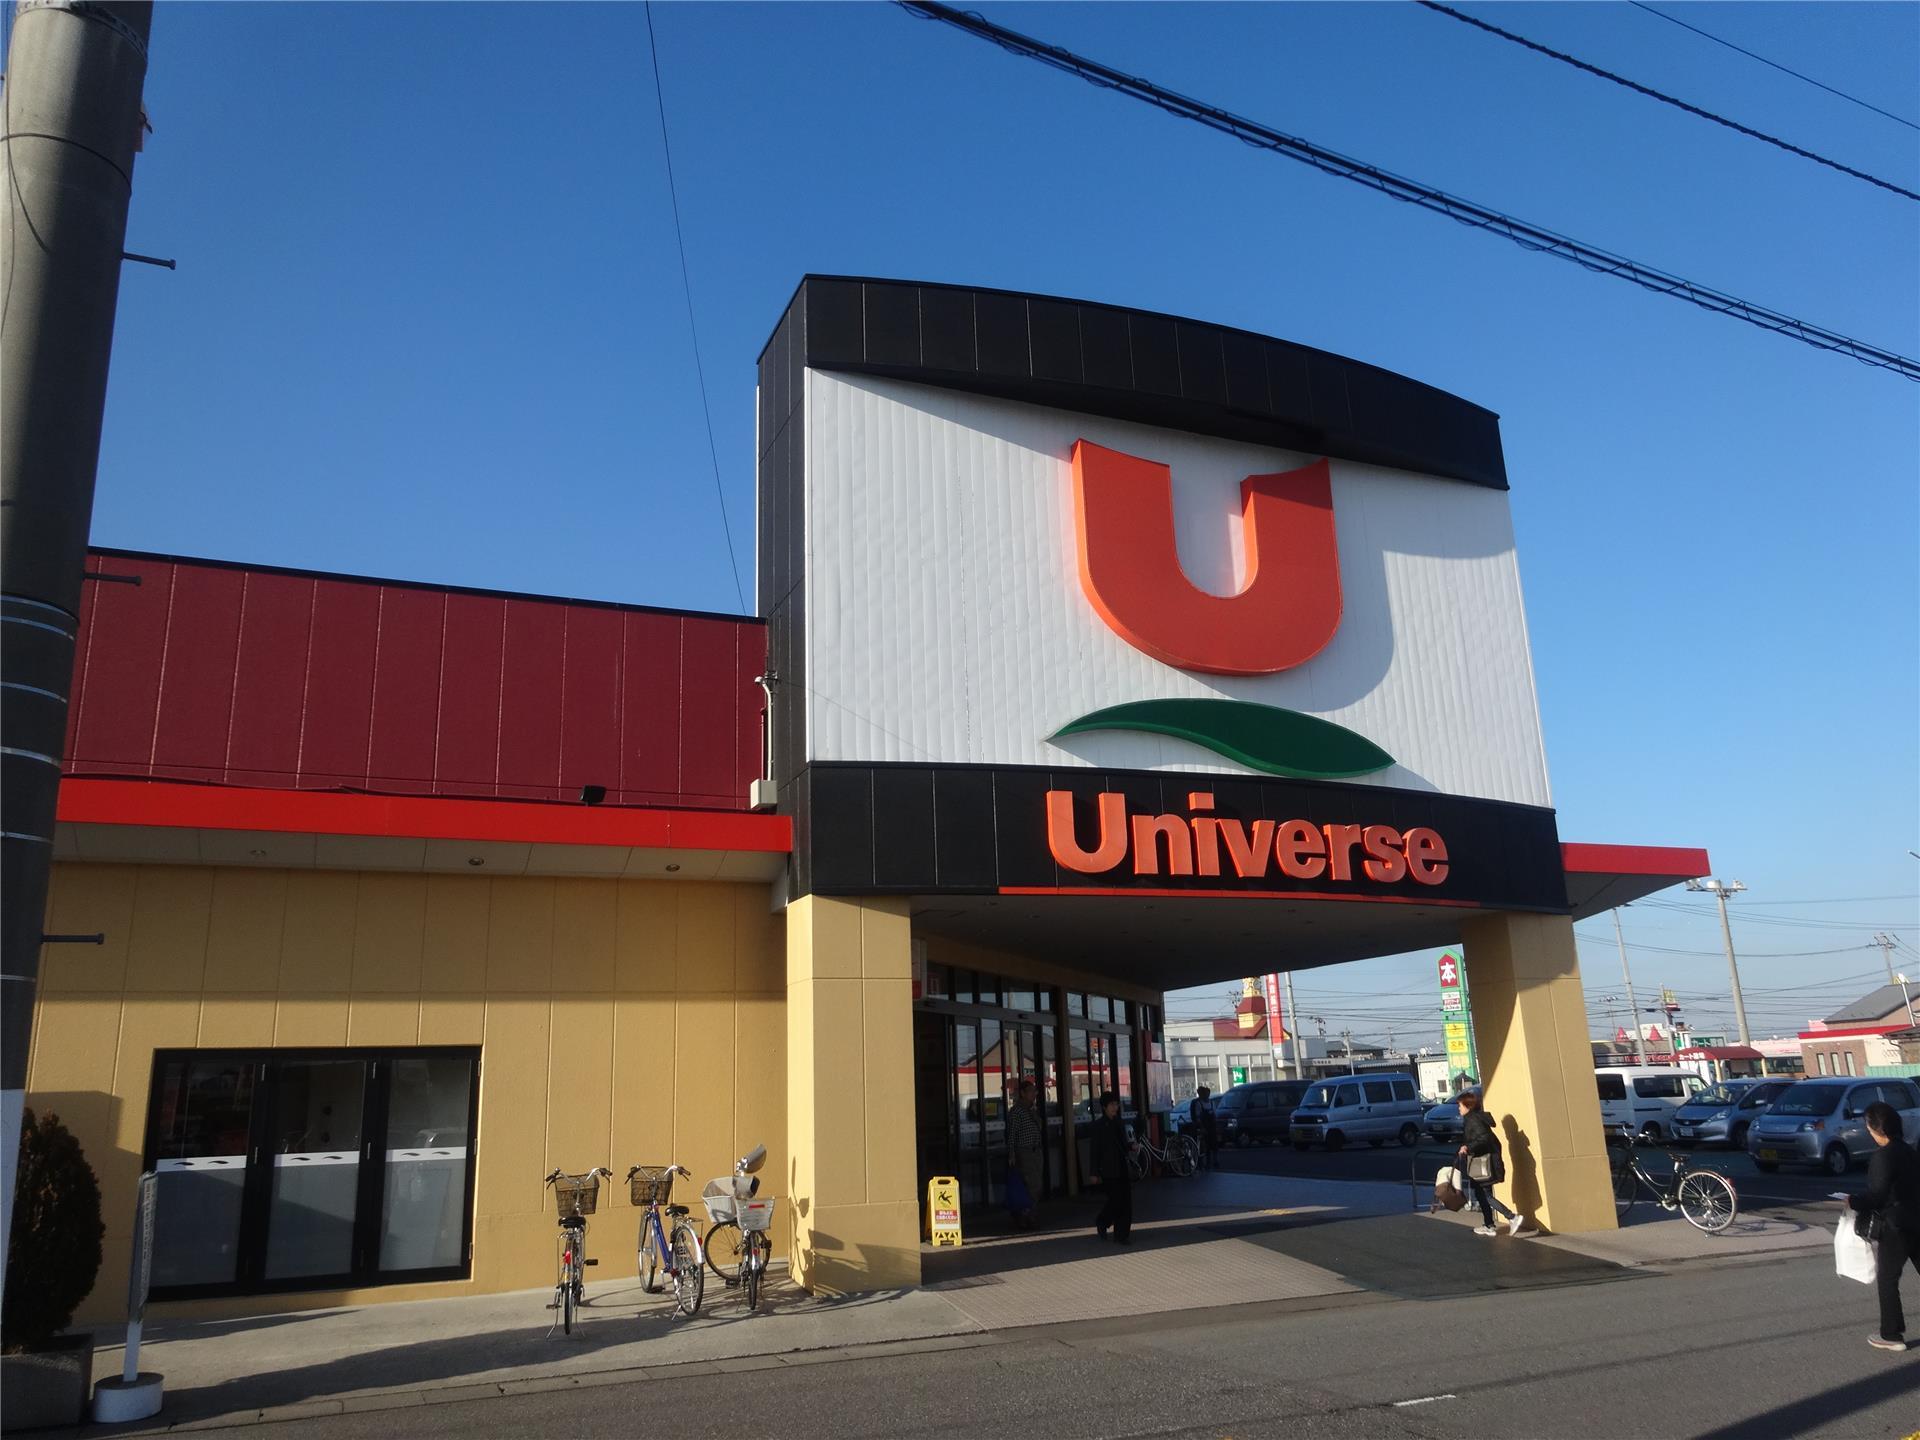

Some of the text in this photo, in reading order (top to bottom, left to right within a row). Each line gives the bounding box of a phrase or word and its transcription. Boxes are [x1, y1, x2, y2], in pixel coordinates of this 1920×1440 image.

[1071, 438, 1343, 677] U
[1046, 790, 1449, 886] Universe
[1440, 962, 1456, 983] 本
